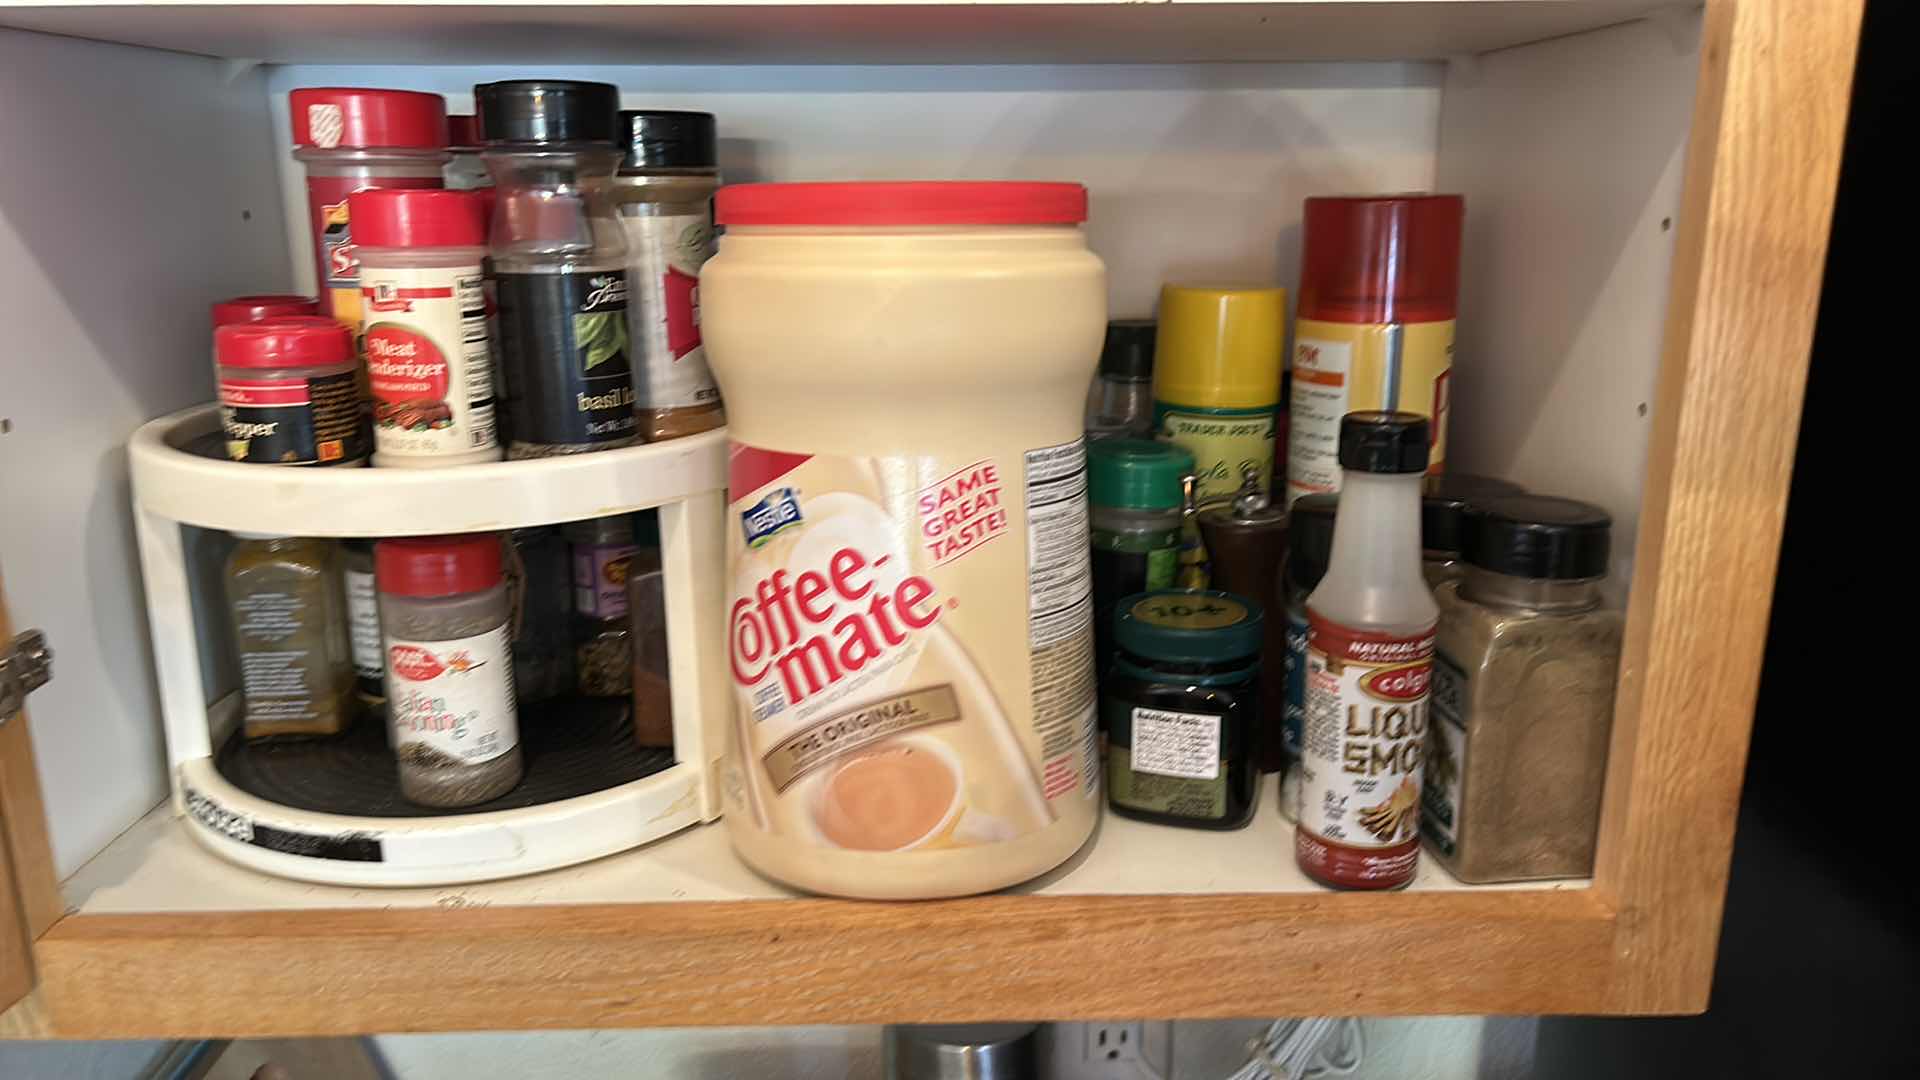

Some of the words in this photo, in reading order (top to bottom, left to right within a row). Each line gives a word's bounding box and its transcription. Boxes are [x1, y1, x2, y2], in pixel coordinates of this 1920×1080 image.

[576, 387, 620, 412] basil
[918, 464, 1000, 516] SAME
[922, 487, 1003, 538] GREAT
[927, 508, 1008, 561] TASTE!
[775, 575, 942, 705] mate
[1348, 640, 1415, 654] NATURAL
[787, 733, 822, 760] THE
[822, 699, 918, 742] ORIGINAL
